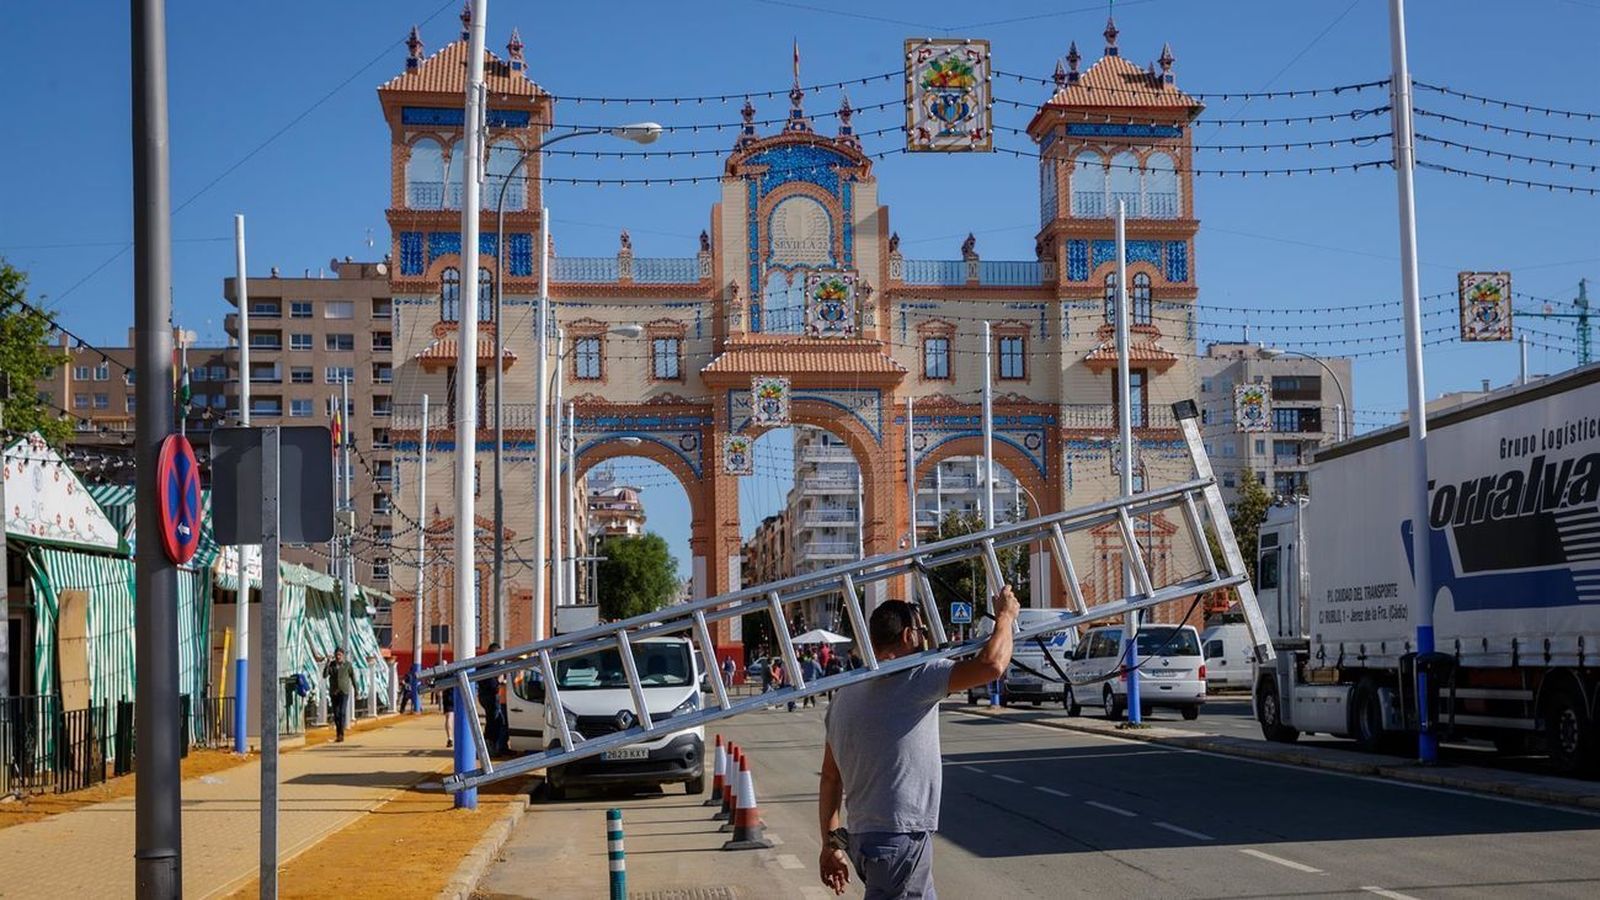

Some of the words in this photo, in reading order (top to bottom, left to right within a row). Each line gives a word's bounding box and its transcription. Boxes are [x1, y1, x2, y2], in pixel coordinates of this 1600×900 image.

[1500, 434, 1536, 459] Grupo
[1335, 587, 1353, 603] CIUDAD
[1354, 586, 1363, 601] DEL
[1364, 583, 1398, 600] TRANSPORTE
[1350, 608, 1364, 622] Jerez
